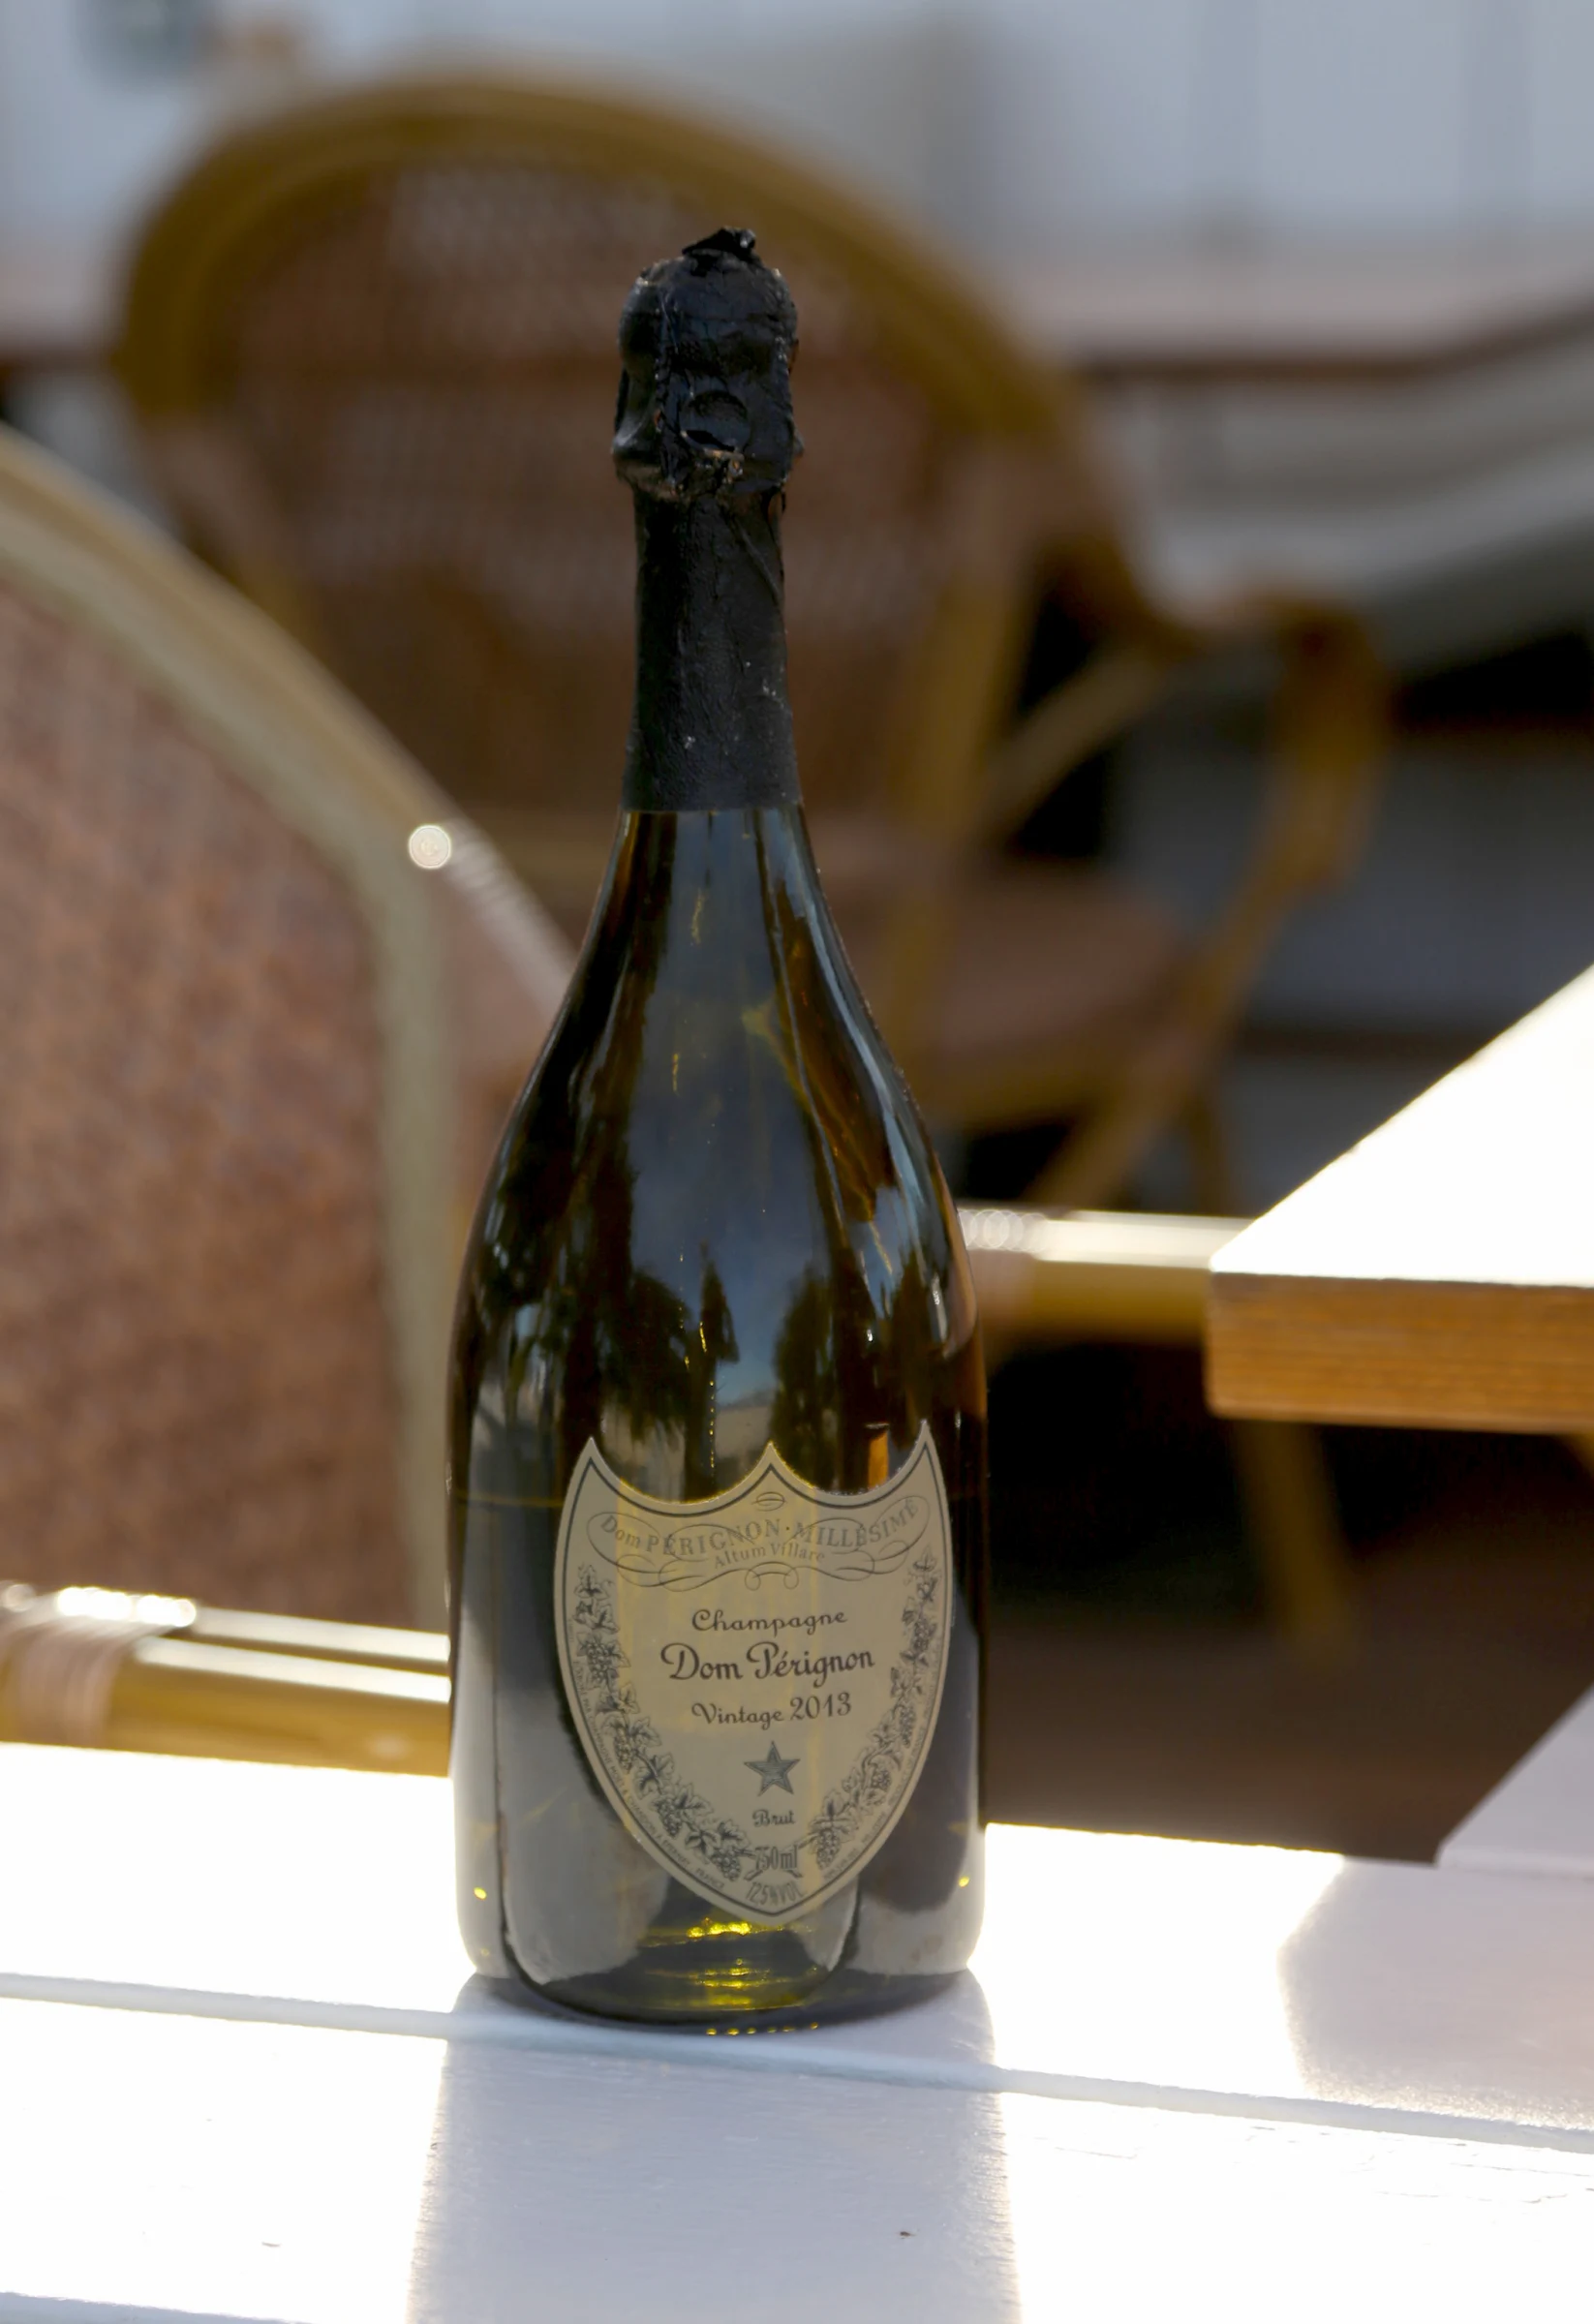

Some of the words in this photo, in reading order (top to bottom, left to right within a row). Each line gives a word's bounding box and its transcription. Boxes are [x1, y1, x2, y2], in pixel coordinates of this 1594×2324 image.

[599, 1514, 641, 1549] Dom
[714, 1544, 767, 1569] Altum
[772, 1542, 826, 1561] Villare
[691, 1608, 847, 1636] Champagne
[660, 1641, 744, 1681] Dom
[746, 1641, 875, 1689] Pérignon
[691, 1701, 784, 1730] Vintage
[789, 1692, 851, 1722] 2013
[752, 1809, 796, 1828] Brut
